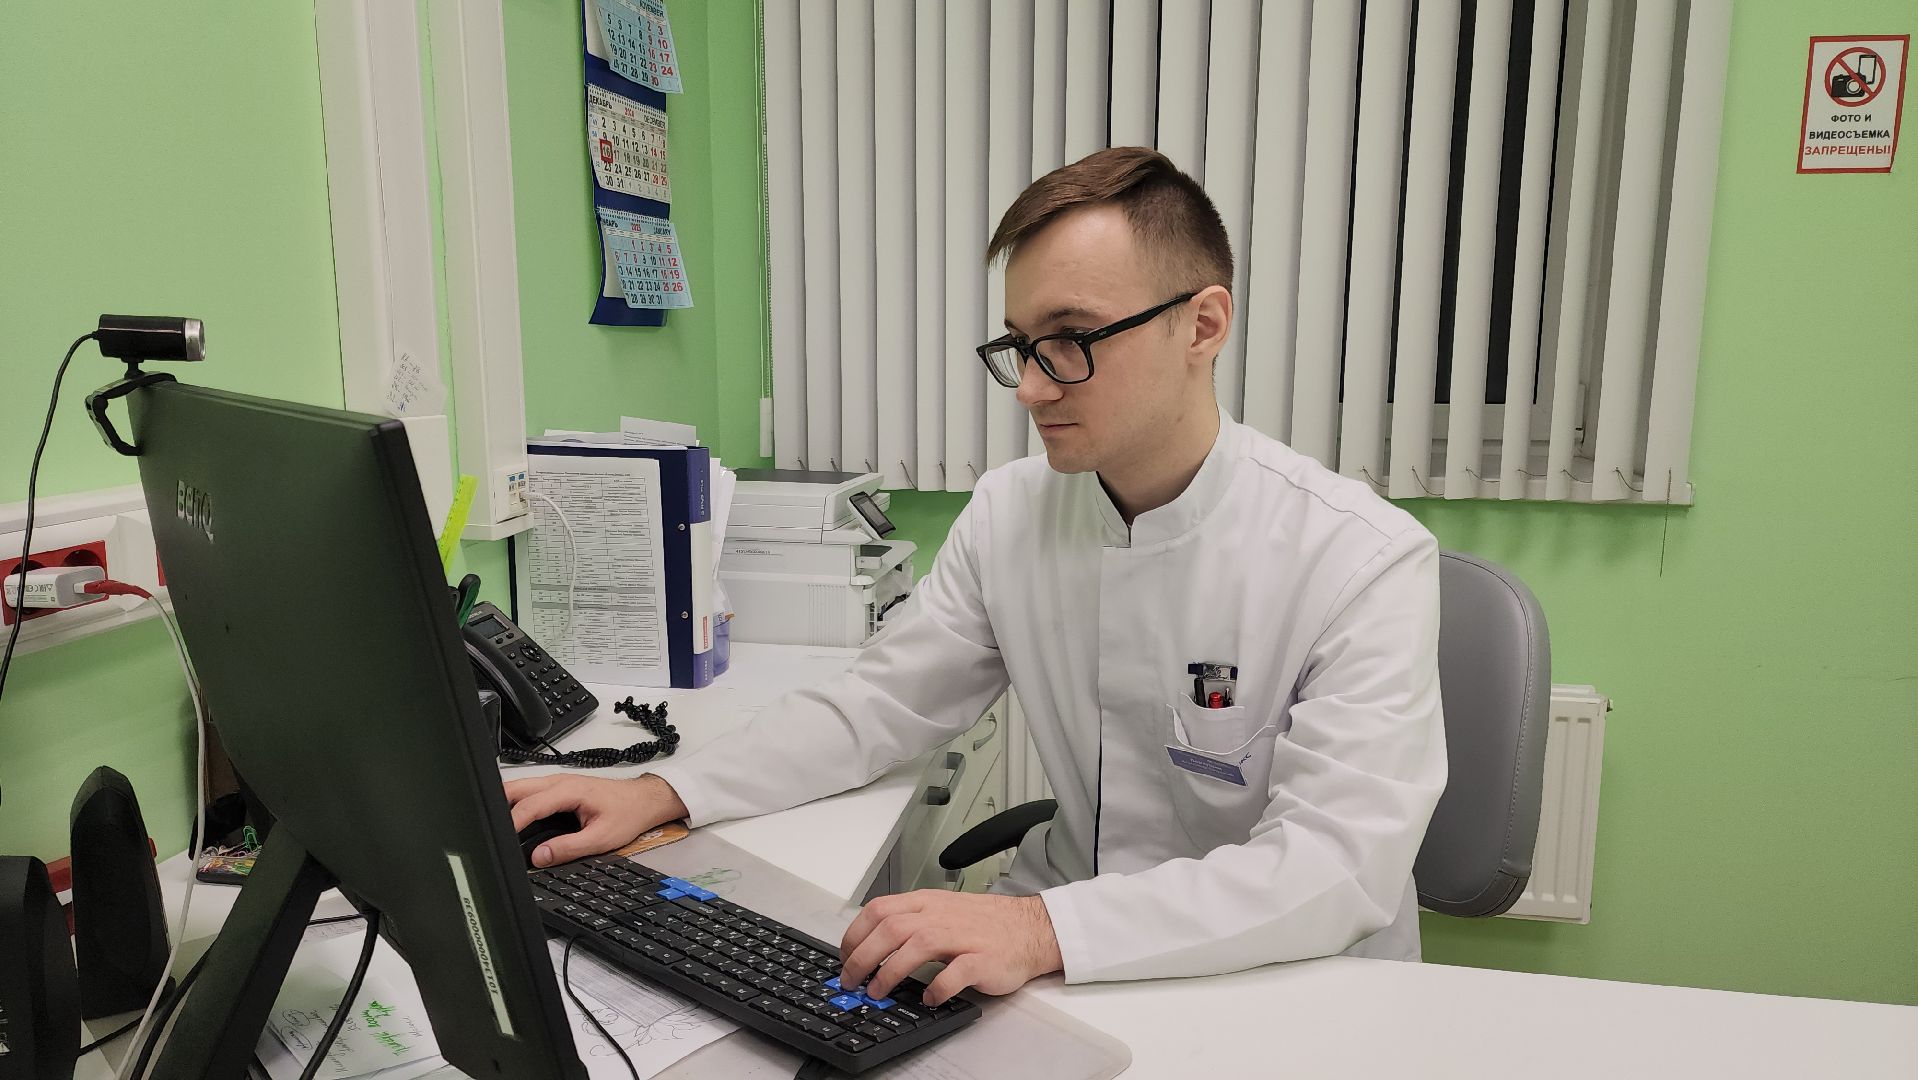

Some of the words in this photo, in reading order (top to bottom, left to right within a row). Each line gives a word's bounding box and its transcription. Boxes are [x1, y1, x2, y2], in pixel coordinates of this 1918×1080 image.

[608, 14, 611, 24] 5
[628, 24, 631, 34] 7
[649, 35, 652, 44] 9
[658, 39, 667, 49] 10
[647, 21, 651, 31] 2
[658, 26, 663, 35] 3
[608, 28, 615, 40] 12
[618, 33, 625, 45] 13
[628, 39, 635, 50] 14
[639, 43, 645, 55] 15
[648, 48, 655, 59] 16
[660, 52, 669, 62] 17
[619, 48, 626, 59] 20
[630, 53, 636, 65] 21
[640, 58, 647, 69] 22
[649, 62, 657, 73] 23
[661, 66, 673, 76] 24
[621, 62, 627, 74] 27
[642, 71, 648, 82] 29
[590, 95, 612, 109] ДЕКАБРЬ
[1830, 114, 1861, 122] ФОТО
[602, 117, 606, 128] 2
[613, 121, 616, 131] 3
[623, 124, 626, 135] 4
[632, 128, 636, 138] 5
[642, 131, 645, 140] 6
[651, 134, 654, 143] 7
[1808, 130, 1890, 140] ВИДЕОСЪЕМКА
[603, 132, 607, 140] 9
[612, 134, 619, 146] 10
[623, 138, 629, 149] 11
[632, 142, 639, 152] 12
[651, 147, 657, 157] 14
[660, 150, 665, 160] 15
[1804, 145, 1891, 156] ЗАПРЕЩЕНЫ!
[603, 144, 610, 157] 16
[614, 150, 620, 160] 17
[624, 152, 630, 163] 18
[633, 155, 640, 165] 19
[604, 161, 612, 172] 23
[615, 163, 622, 174] 24
[625, 166, 632, 176] 25
[634, 169, 642, 179] 26
[644, 171, 650, 181] 27
[653, 174, 658, 184] 28
[661, 176, 667, 185] 29
[605, 176, 613, 186] 30
[617, 178, 624, 188] 31
[641, 241, 644, 251] 2
[650, 243, 654, 252] 3
[658, 244, 661, 253] 4
[667, 245, 671, 254] 5
[624, 253, 627, 262] 7
[651, 256, 656, 265] 10
[659, 257, 665, 266] 11
[668, 258, 678, 266] 12
[626, 266, 632, 276] 14
[635, 268, 641, 277] 15
[643, 268, 650, 277] 16
[670, 270, 679, 278] 19
[629, 281, 634, 290] 21
[637, 281, 643, 290] 22
[646, 282, 652, 290] 23
[654, 282, 660, 291] 24
[672, 283, 683, 292] 26
[656, 294, 662, 304] 31
